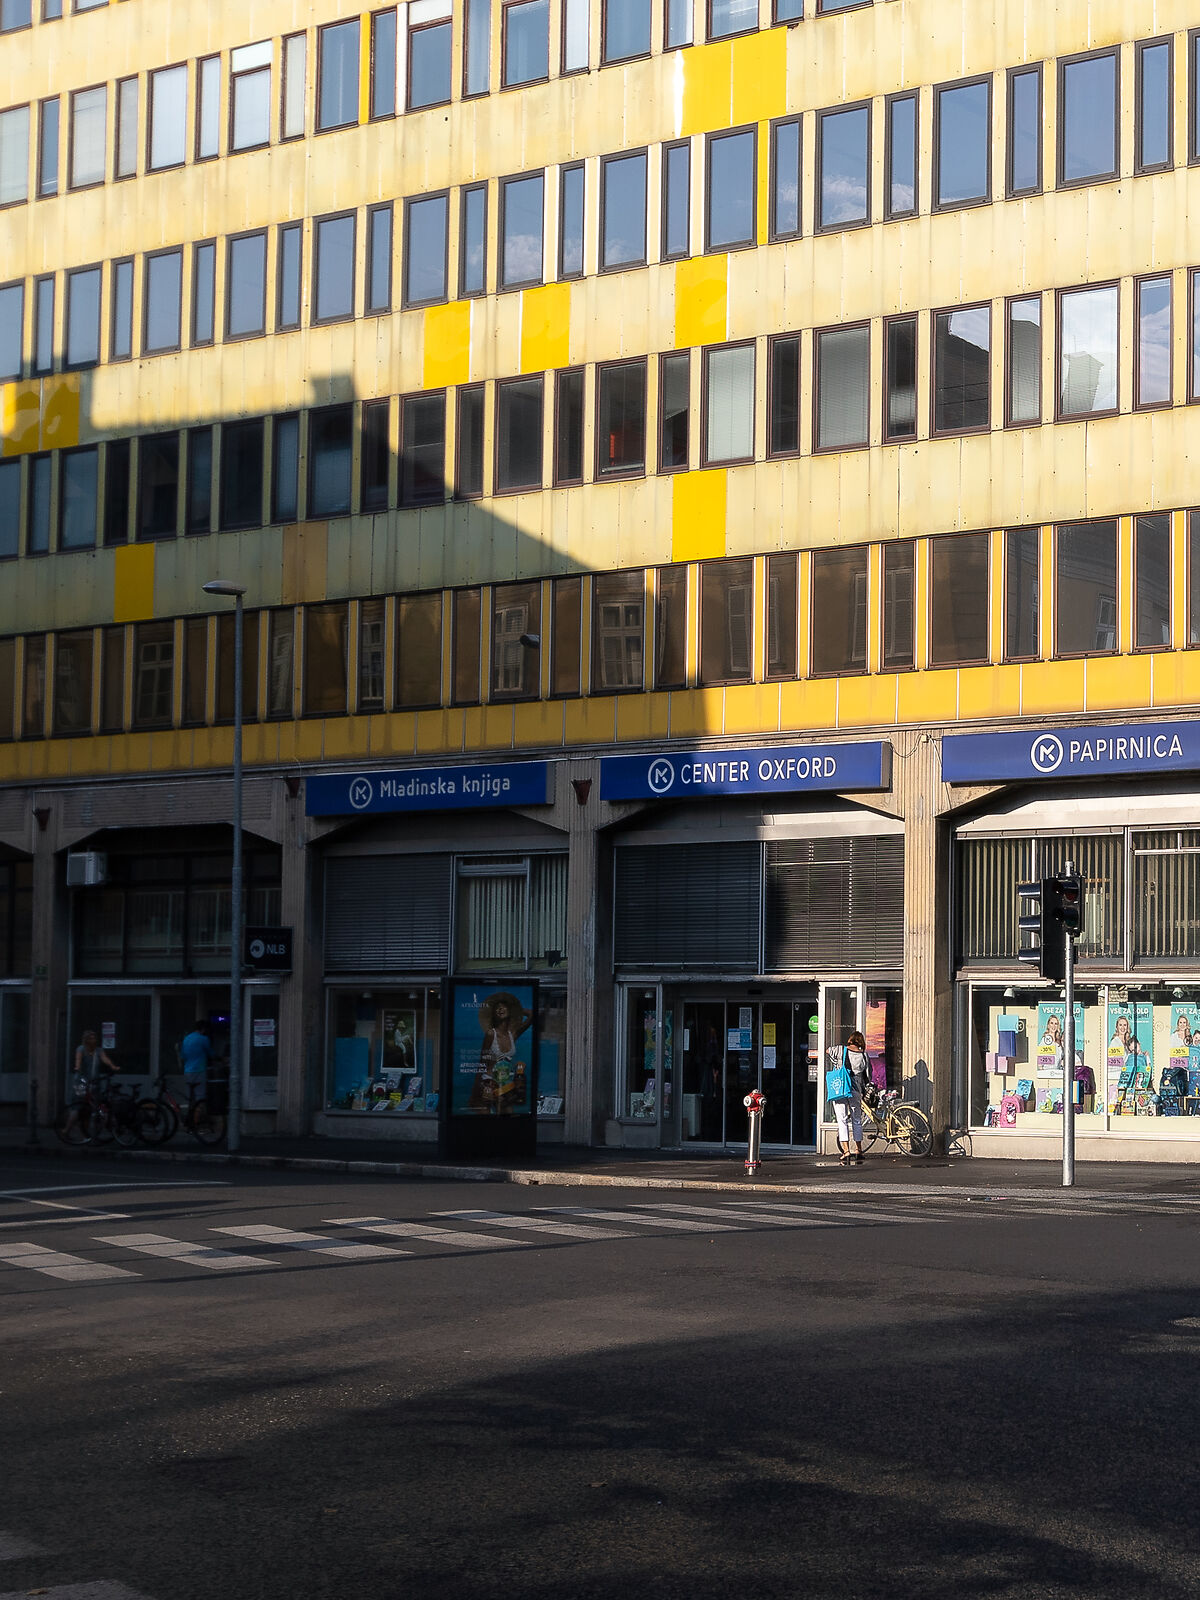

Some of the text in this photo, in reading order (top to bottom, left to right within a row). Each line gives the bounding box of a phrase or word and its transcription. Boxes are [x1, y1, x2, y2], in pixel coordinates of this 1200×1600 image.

[1069, 734, 1183, 763] PAPIRNICA
[681, 761, 749, 784] CENTER
[758, 756, 837, 781] OXFORD
[380, 776, 456, 798] Mladinska
[462, 773, 511, 797] knjiga
[265, 943, 287, 955] NLB
[1175, 1007, 1187, 1015] VSE
